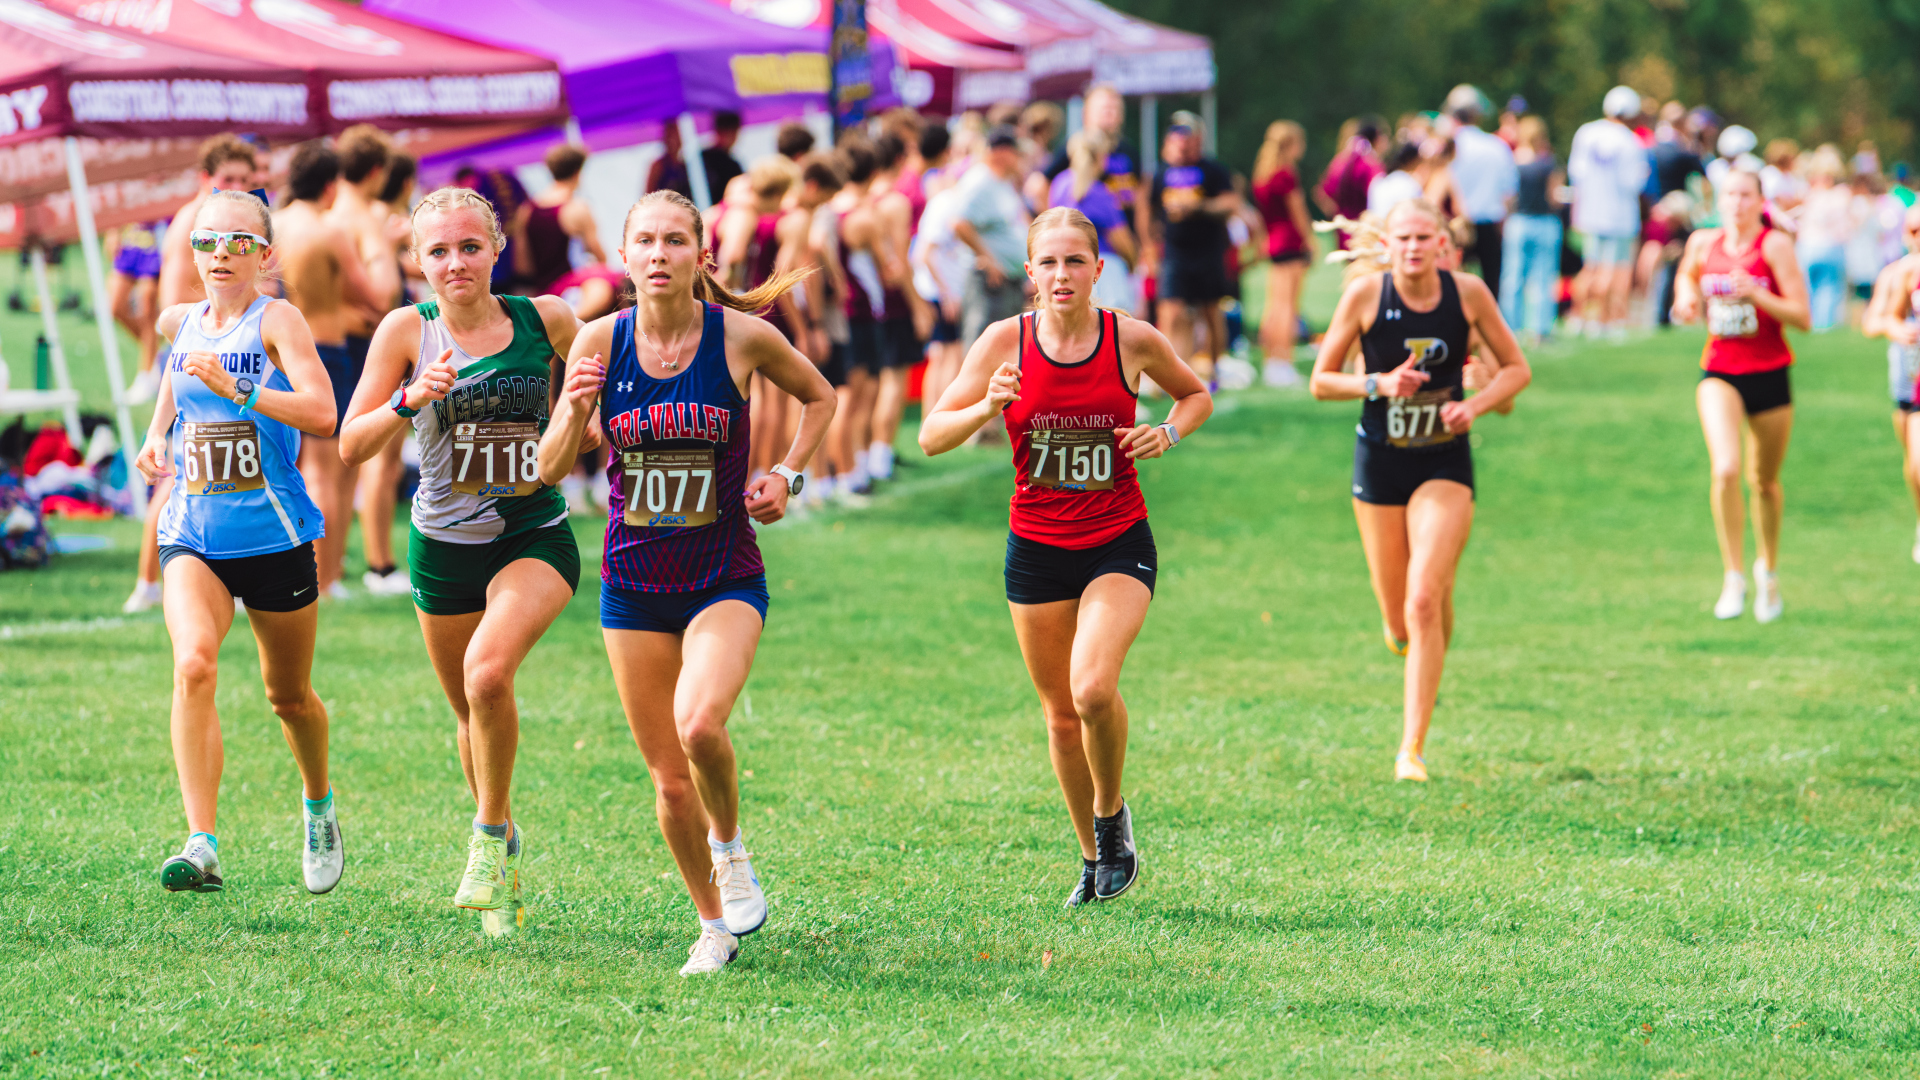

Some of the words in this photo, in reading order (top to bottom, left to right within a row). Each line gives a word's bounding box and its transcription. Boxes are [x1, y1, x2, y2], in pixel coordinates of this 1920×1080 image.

[218, 352, 262, 375] OONE
[432, 375, 550, 435] WELLSBOR
[1030, 414, 1115, 430] MILLIONAIRES
[1034, 411, 1059, 421] Lady
[1387, 404, 1451, 438] 677
[609, 402, 730, 450] TRI-VALLEY
[184, 438, 259, 482] 6178
[454, 440, 540, 483] 7118
[1030, 443, 1112, 482] 7150
[624, 469, 713, 513] 7077
